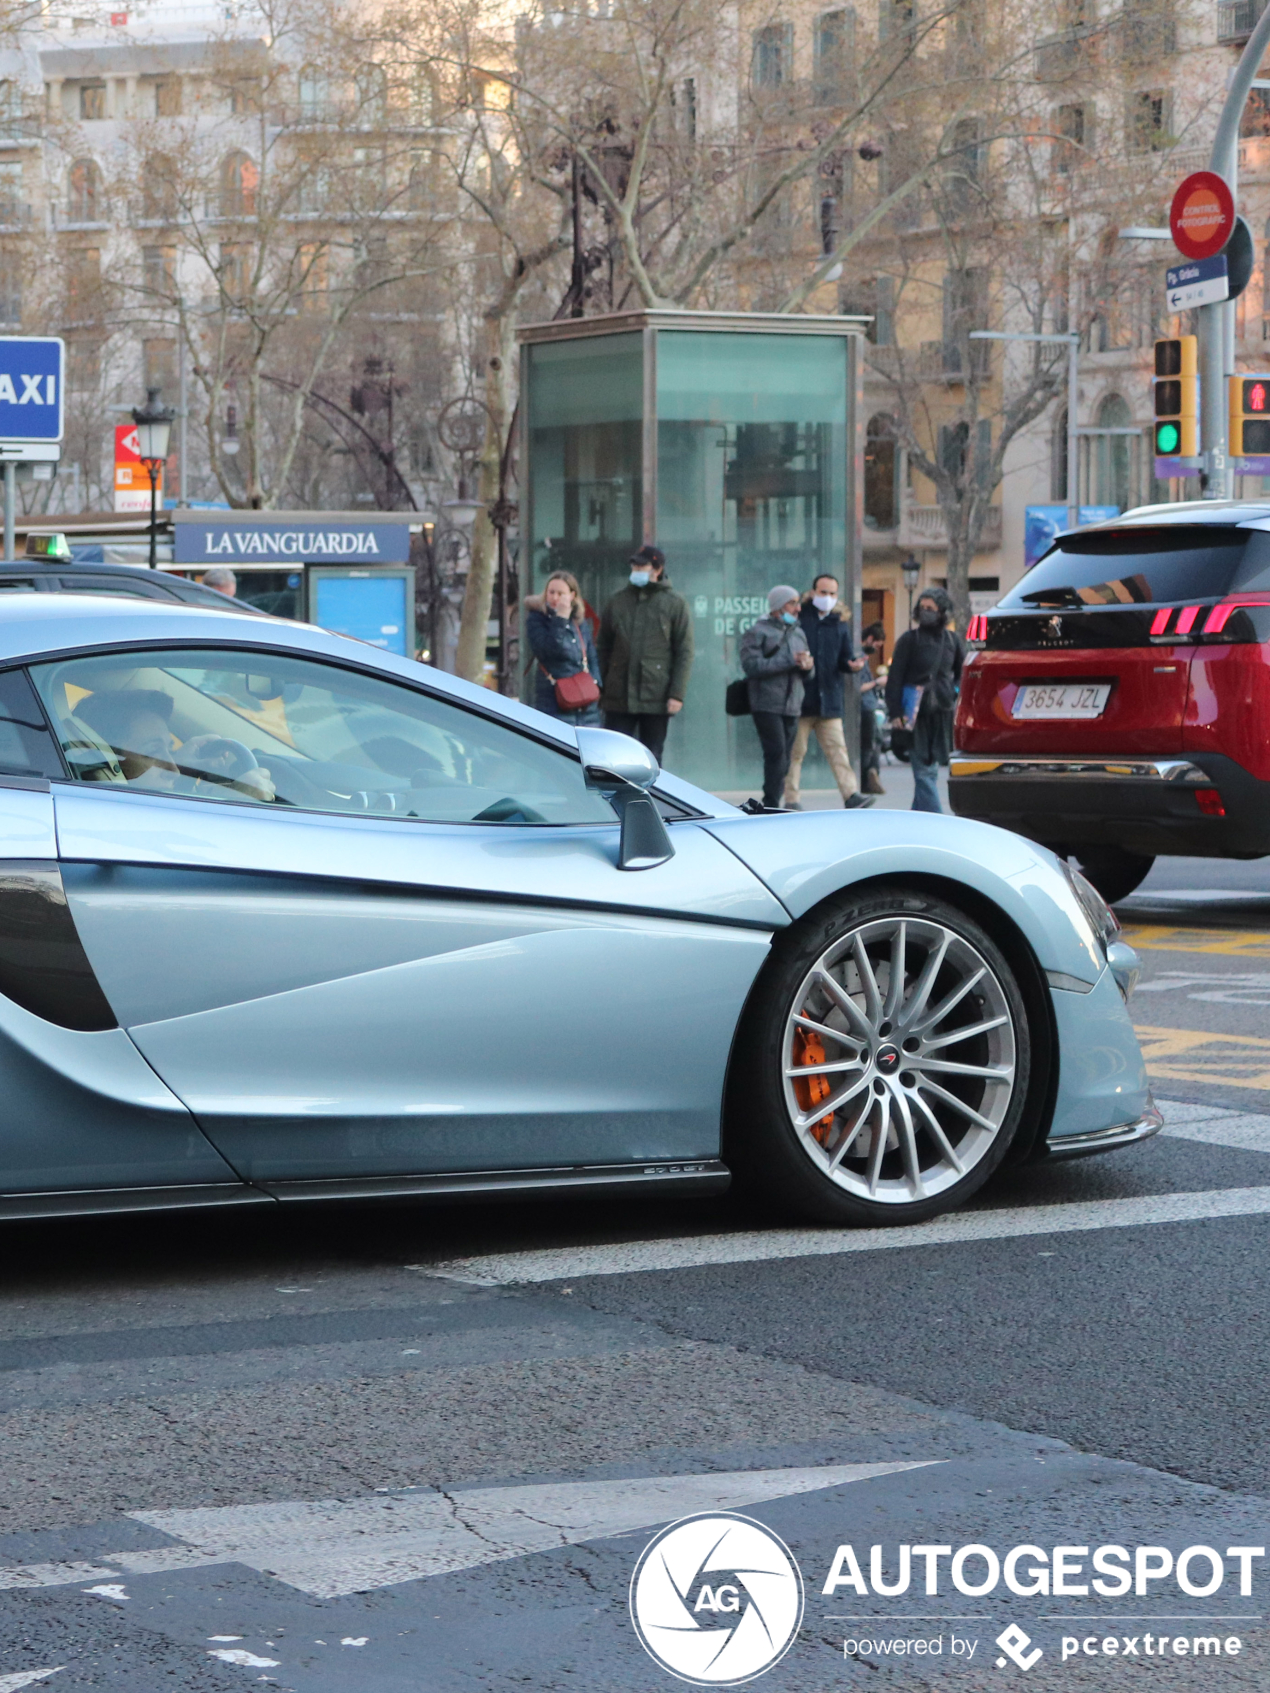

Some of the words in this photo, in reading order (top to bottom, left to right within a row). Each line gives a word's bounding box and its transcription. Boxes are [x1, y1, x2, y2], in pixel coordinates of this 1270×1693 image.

[1183, 204, 1220, 216] CONTROL
[206, 532, 234, 554] LA
[234, 532, 380, 555] VANGUARDIA
[714, 617, 735, 635] DE
[1025, 687, 1066, 709] 3654
[1071, 687, 1101, 709] JZL
